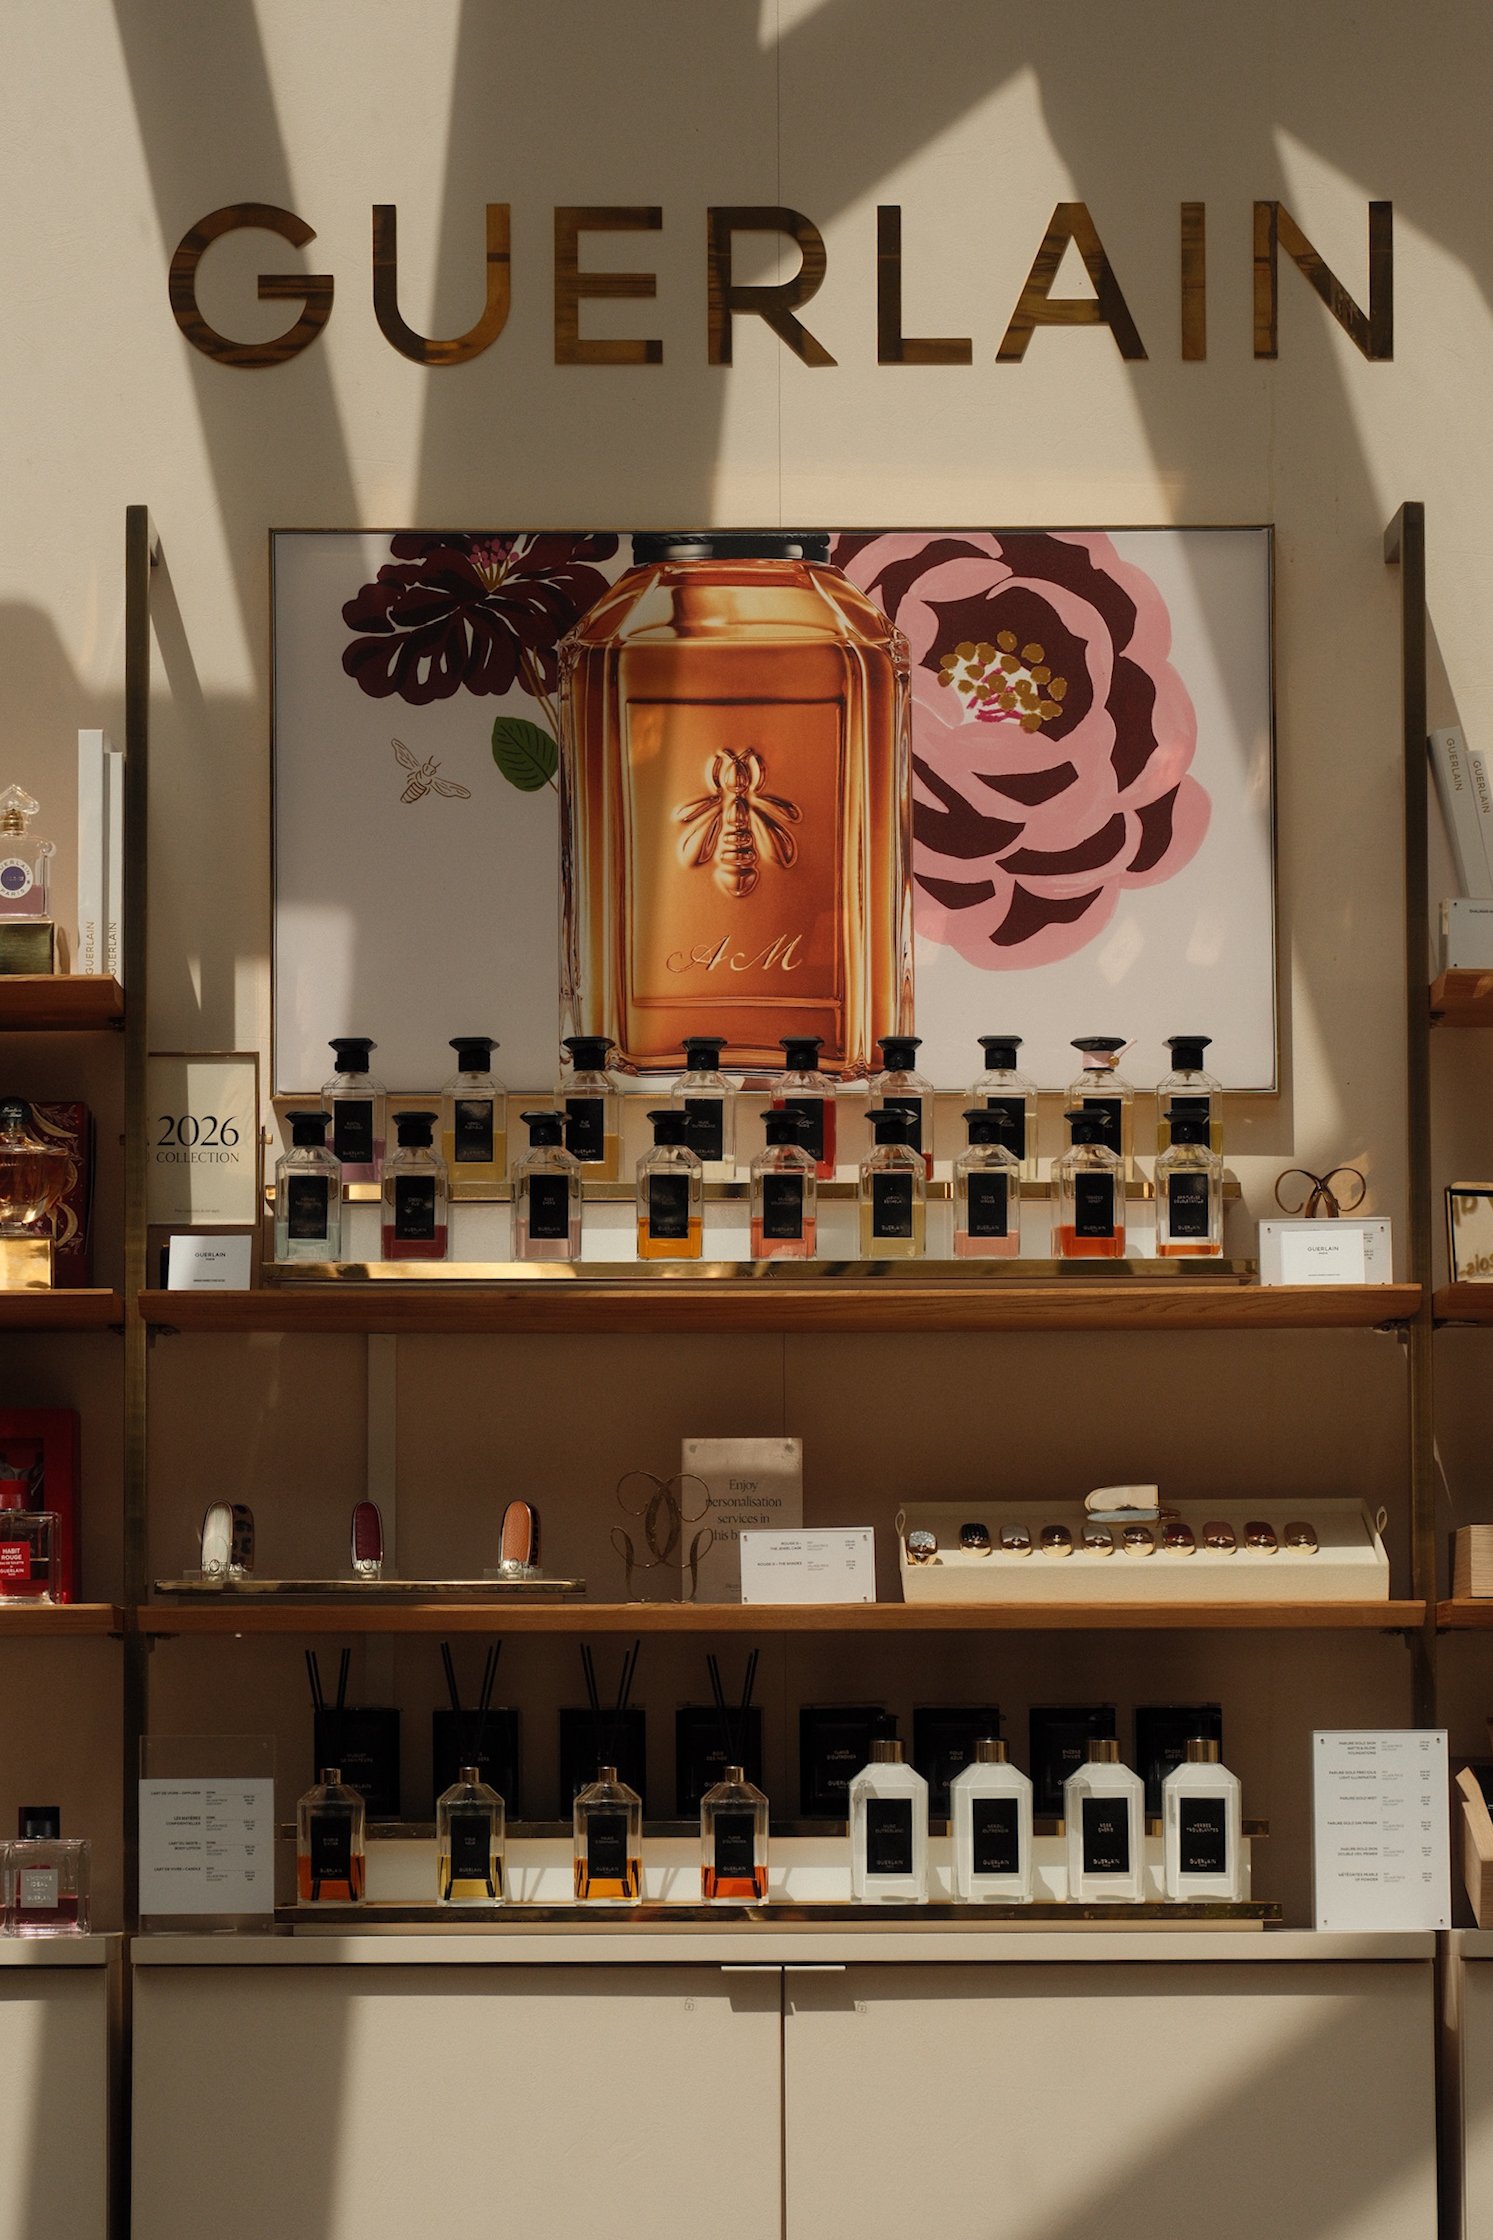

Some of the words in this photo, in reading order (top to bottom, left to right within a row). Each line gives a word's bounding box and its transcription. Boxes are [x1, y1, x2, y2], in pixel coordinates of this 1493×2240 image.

[168, 201, 1394, 369] GUERLAIN
[1446, 737, 1464, 791] GUERLAIN
[1472, 760, 1490, 814] GUERLAIN
[85, 921, 95, 976] GUERLAIN
[108, 922, 118, 976] GUERLAIN
[156, 1115, 240, 1147] 2026
[156, 1151, 240, 1164] COLLECTION
[729, 1478, 759, 1493] Enjoy
[717, 1512, 758, 1524] services
[759, 1513, 770, 1524] in
[2, 1547, 21, 1555] HABIT
